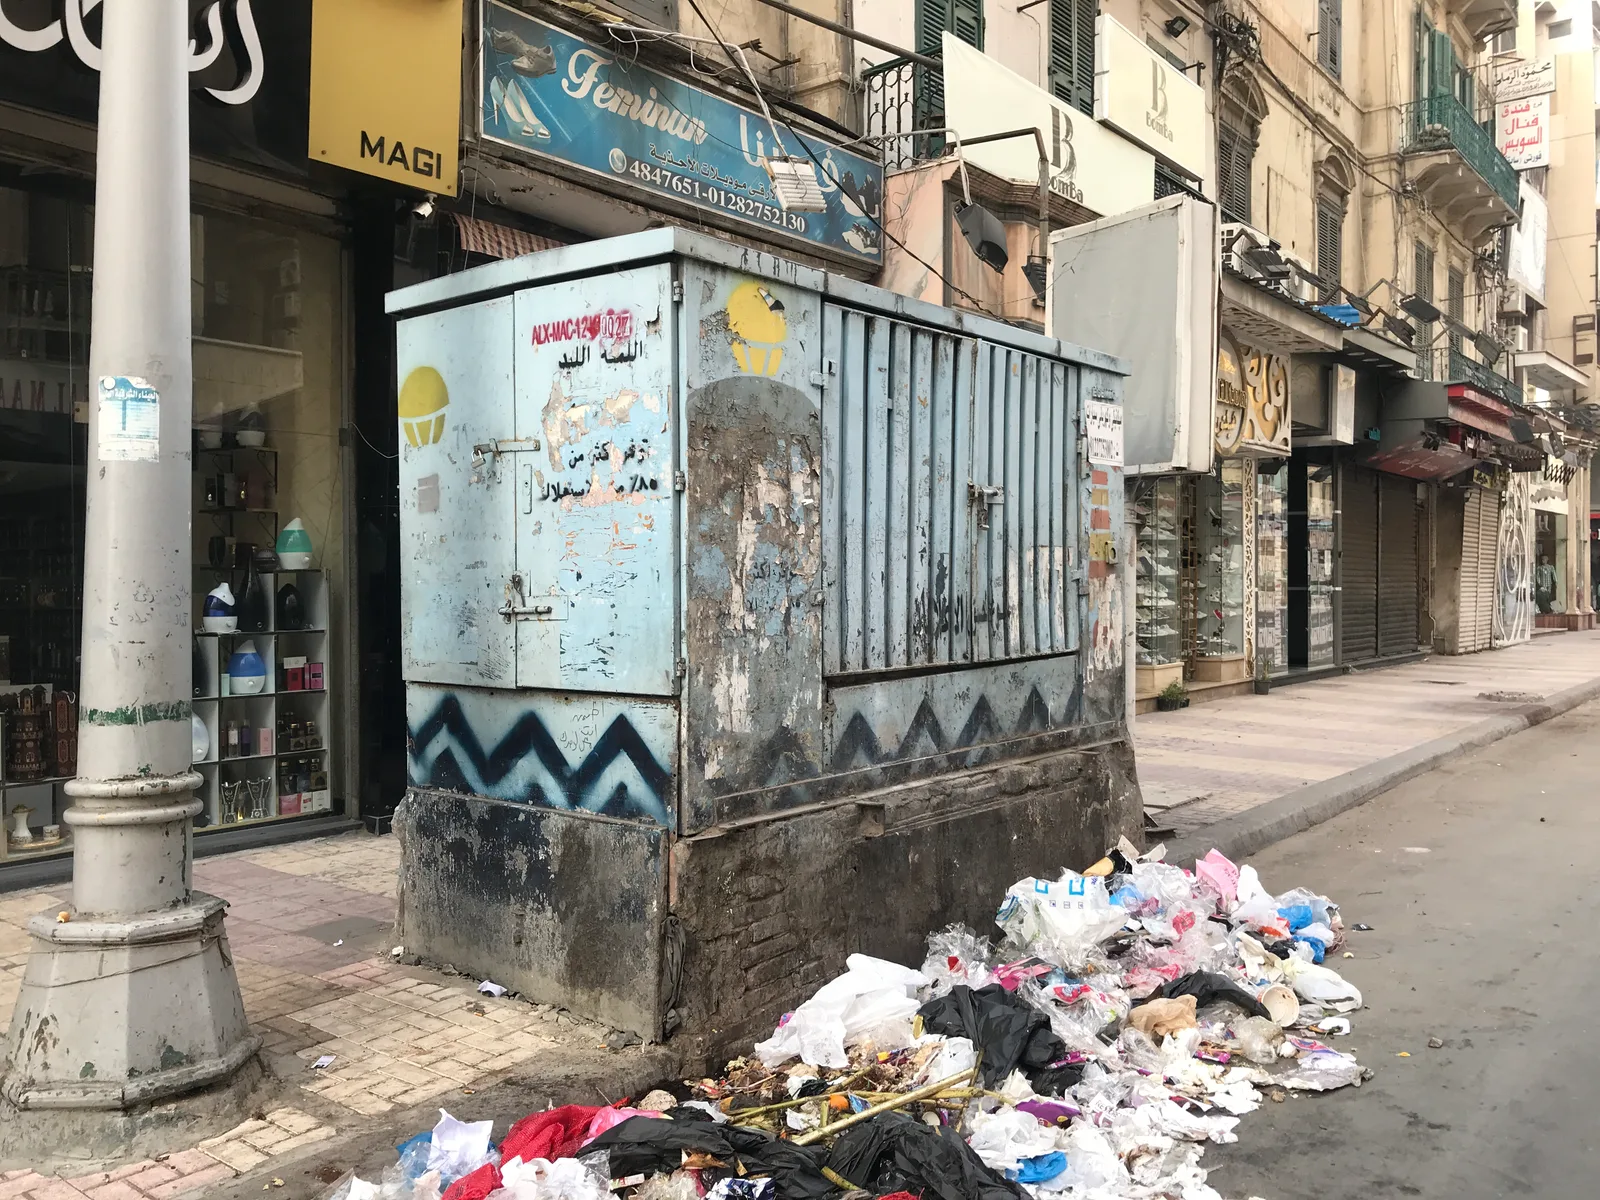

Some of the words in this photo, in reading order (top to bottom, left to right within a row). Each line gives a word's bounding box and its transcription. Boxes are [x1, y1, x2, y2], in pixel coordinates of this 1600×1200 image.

[1501, 100, 1531, 118] فندق
[1504, 114, 1539, 135] قنال
[360, 131, 442, 180] MAGI
[1500, 126, 1543, 156] السويس
[649, 143, 700, 173] الأحذية
[629, 160, 806, 233] 4847651-01282752130
